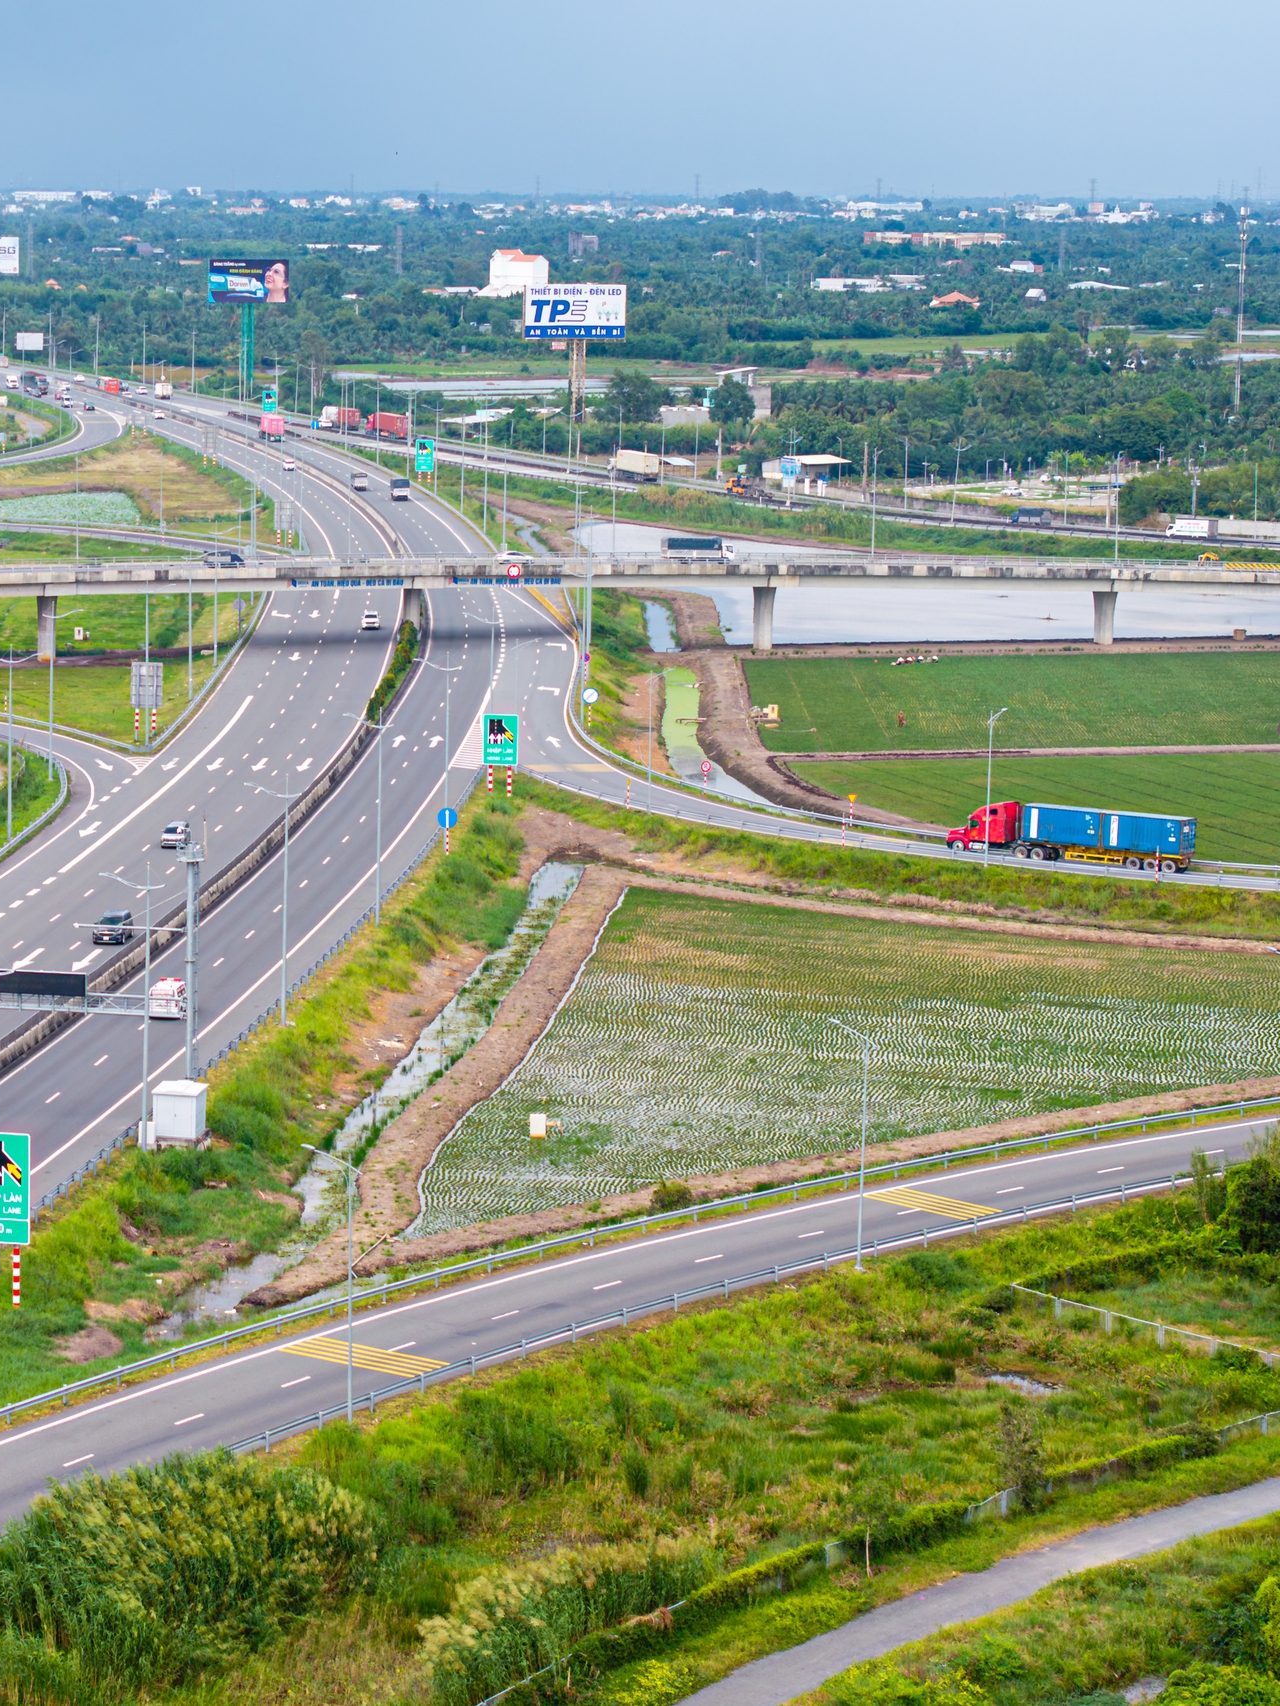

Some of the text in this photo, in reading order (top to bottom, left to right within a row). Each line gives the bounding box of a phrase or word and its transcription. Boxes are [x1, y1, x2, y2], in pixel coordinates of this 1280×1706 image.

[229, 279, 249, 288] Doreen
[530, 286, 552, 296] THIẾT
[554, 288, 561, 297] BỊ
[563, 286, 582, 297] ĐIỆN
[608, 288, 622, 296] LED
[530, 328, 540, 336] AN
[547, 327, 568, 336] TOÀN
[575, 328, 585, 336] VÀ
[3, 1191, 22, 1203] LÀN
[3, 1206, 22, 1214] LANE
